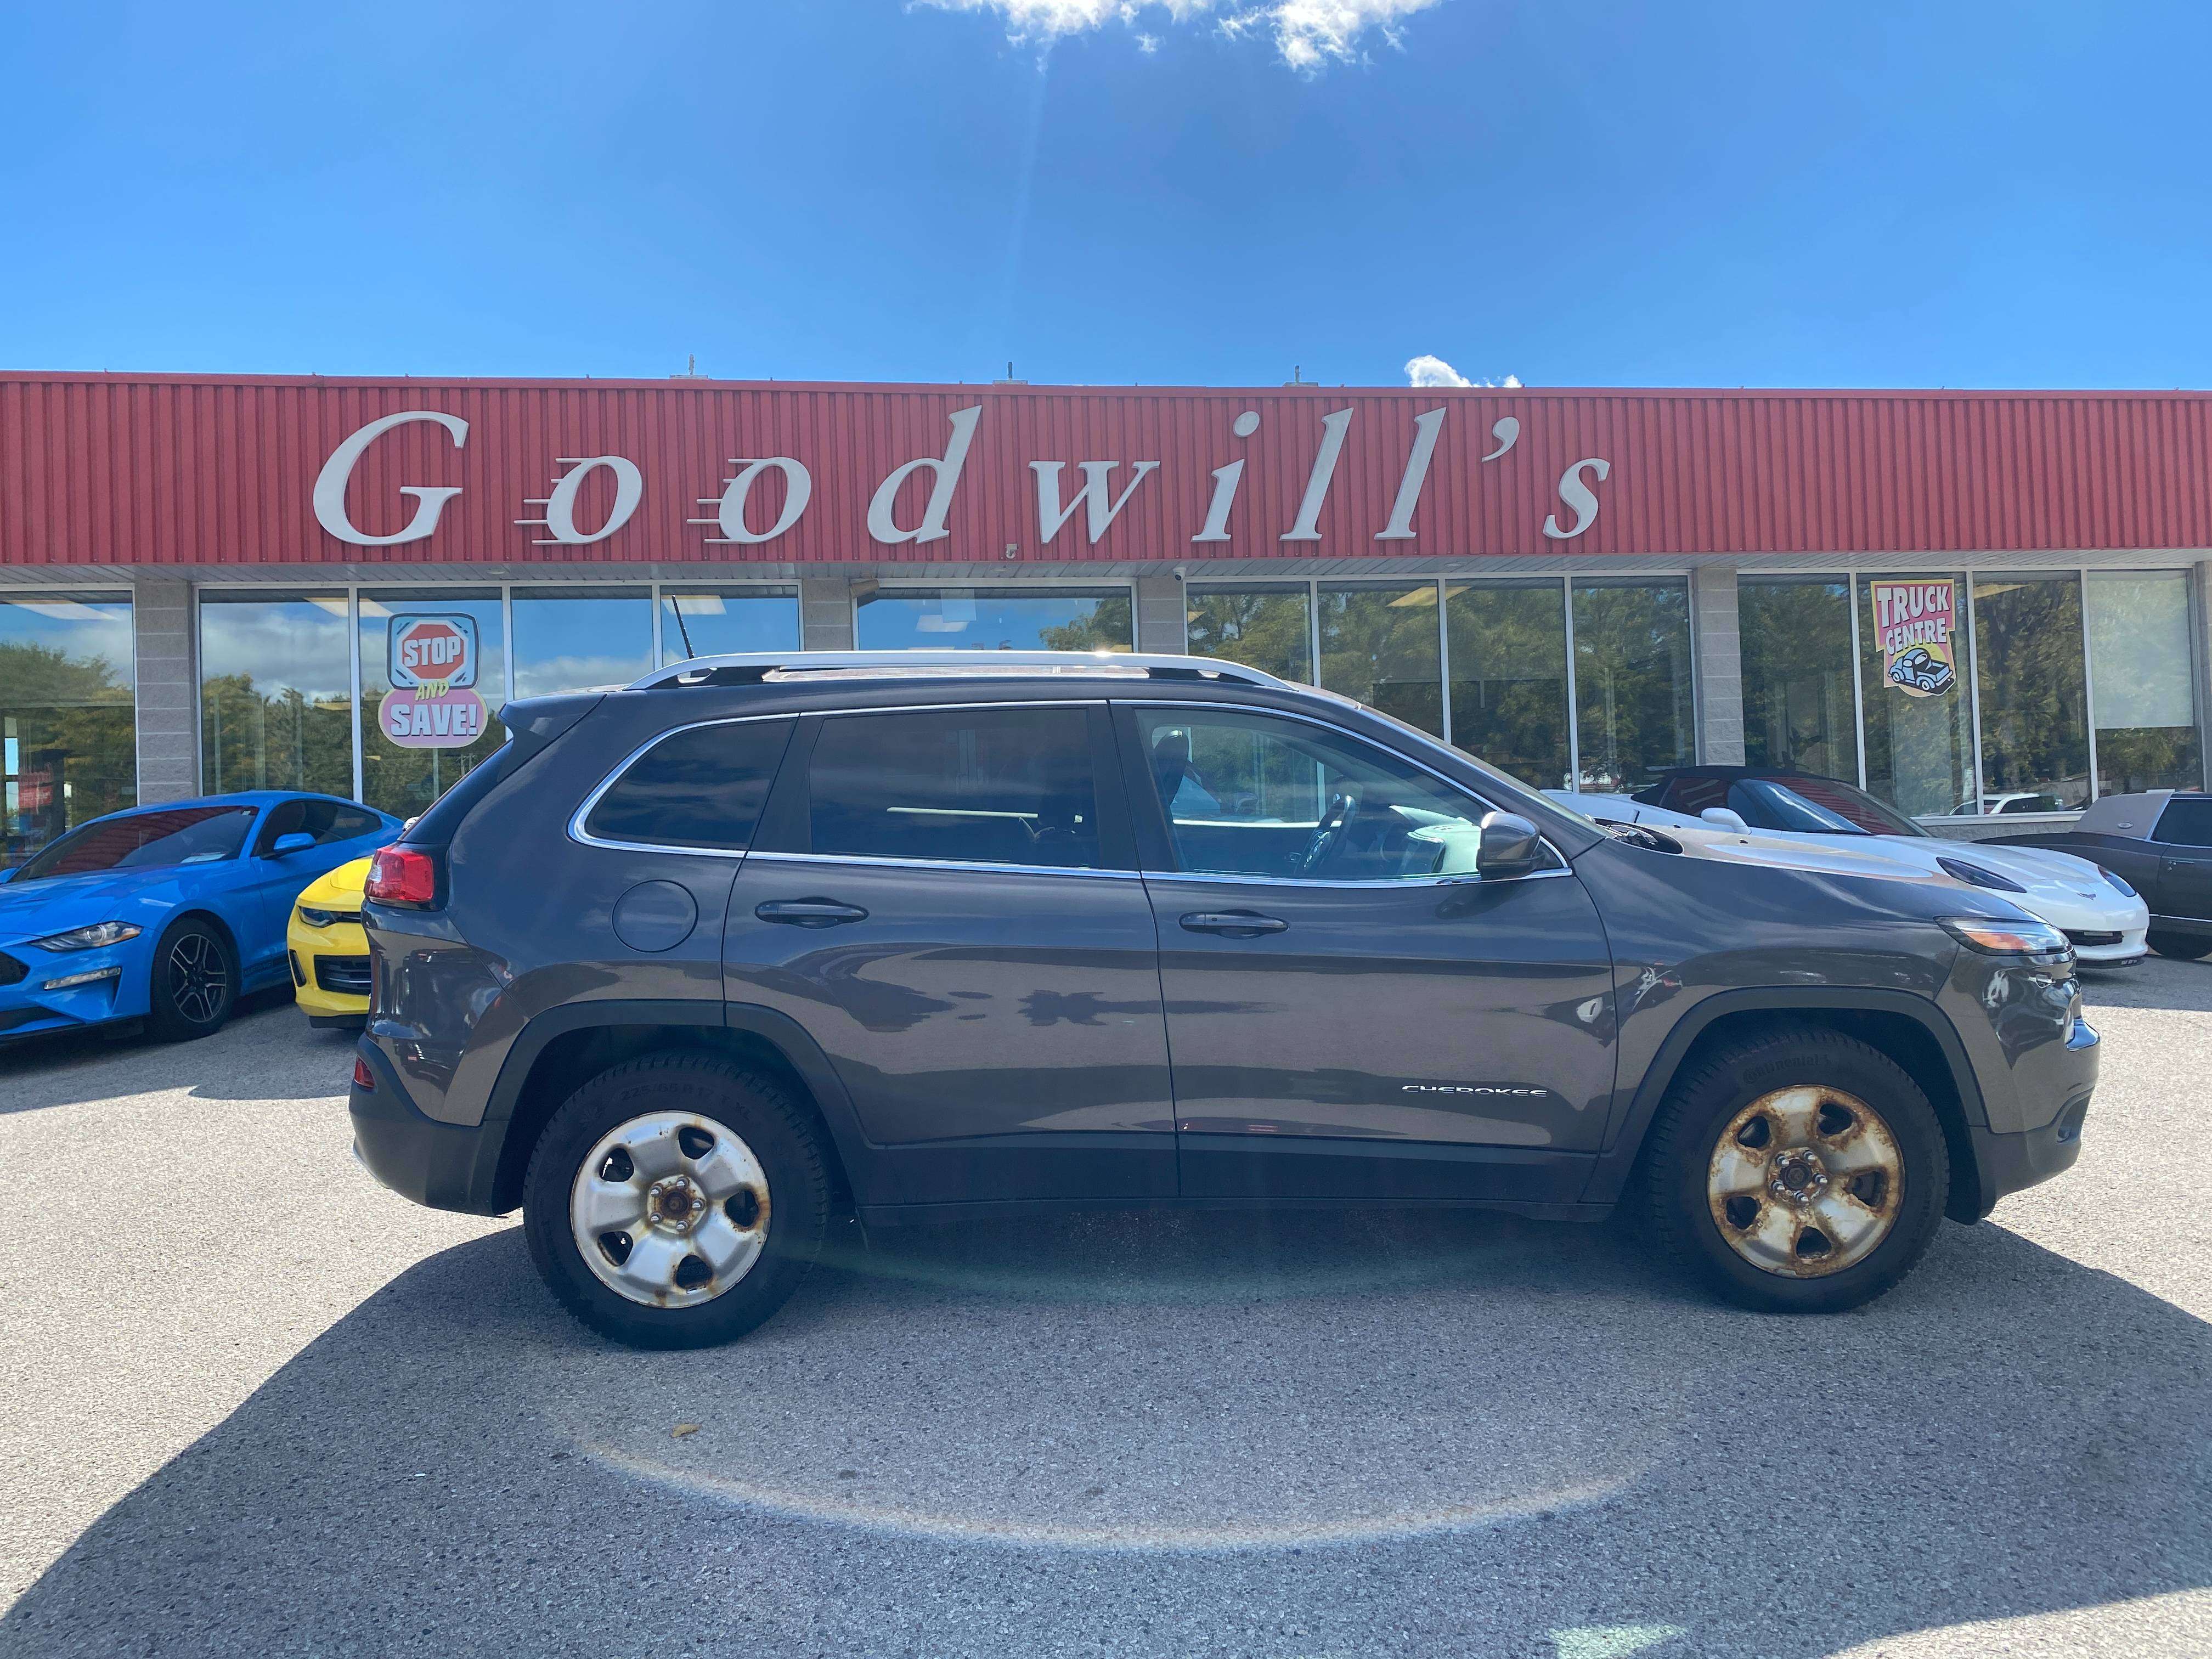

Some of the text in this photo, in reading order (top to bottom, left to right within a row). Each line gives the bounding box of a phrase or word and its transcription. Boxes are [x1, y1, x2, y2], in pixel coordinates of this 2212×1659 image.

[312, 404, 1611, 546] Goodwill's
[1876, 585, 1950, 628] TRUCK
[403, 635, 461, 668] STOP
[1885, 617, 1948, 656] CENTRE
[415, 679, 450, 701] AND
[390, 704, 478, 737] SAVE!
[1402, 1085, 1548, 1097] CHEROKEE
